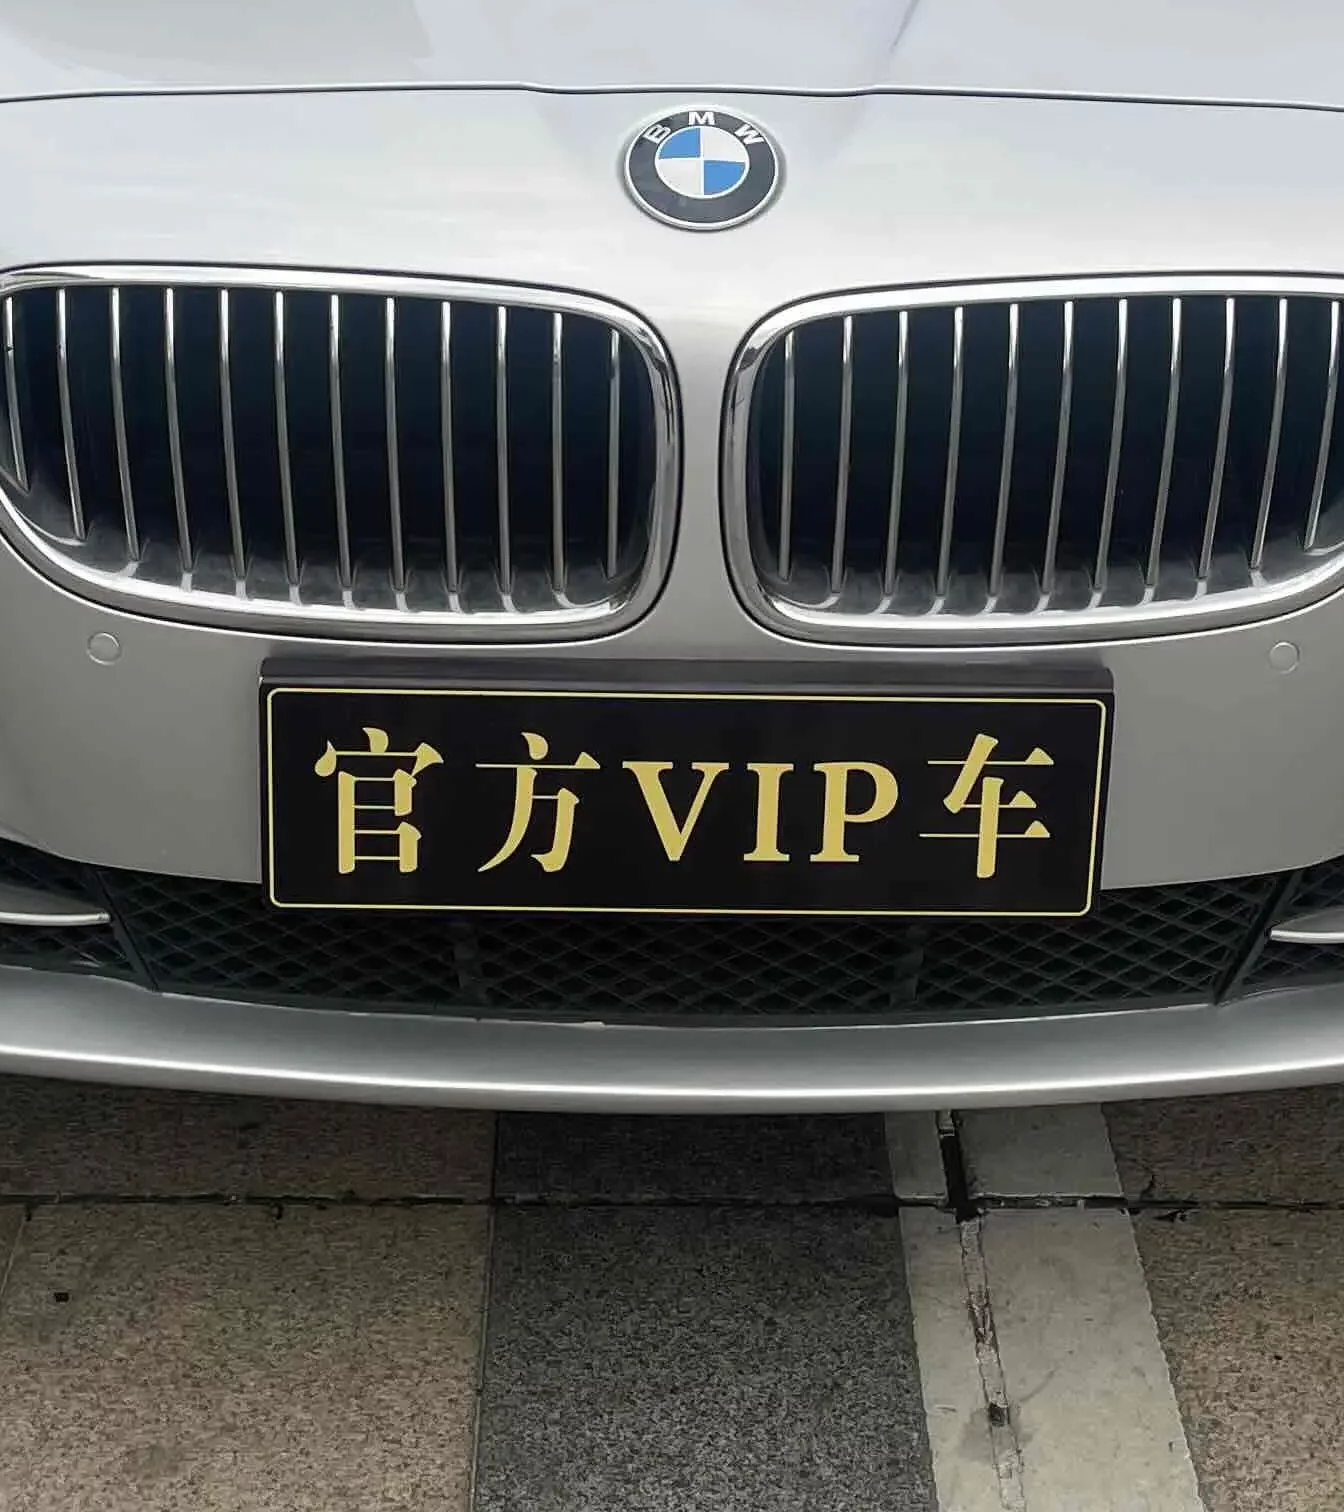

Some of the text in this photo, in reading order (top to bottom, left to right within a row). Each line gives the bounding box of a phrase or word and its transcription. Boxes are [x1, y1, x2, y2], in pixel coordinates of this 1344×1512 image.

[642, 111, 765, 145] BMW
[314, 727, 1055, 879] 官方VIP车
